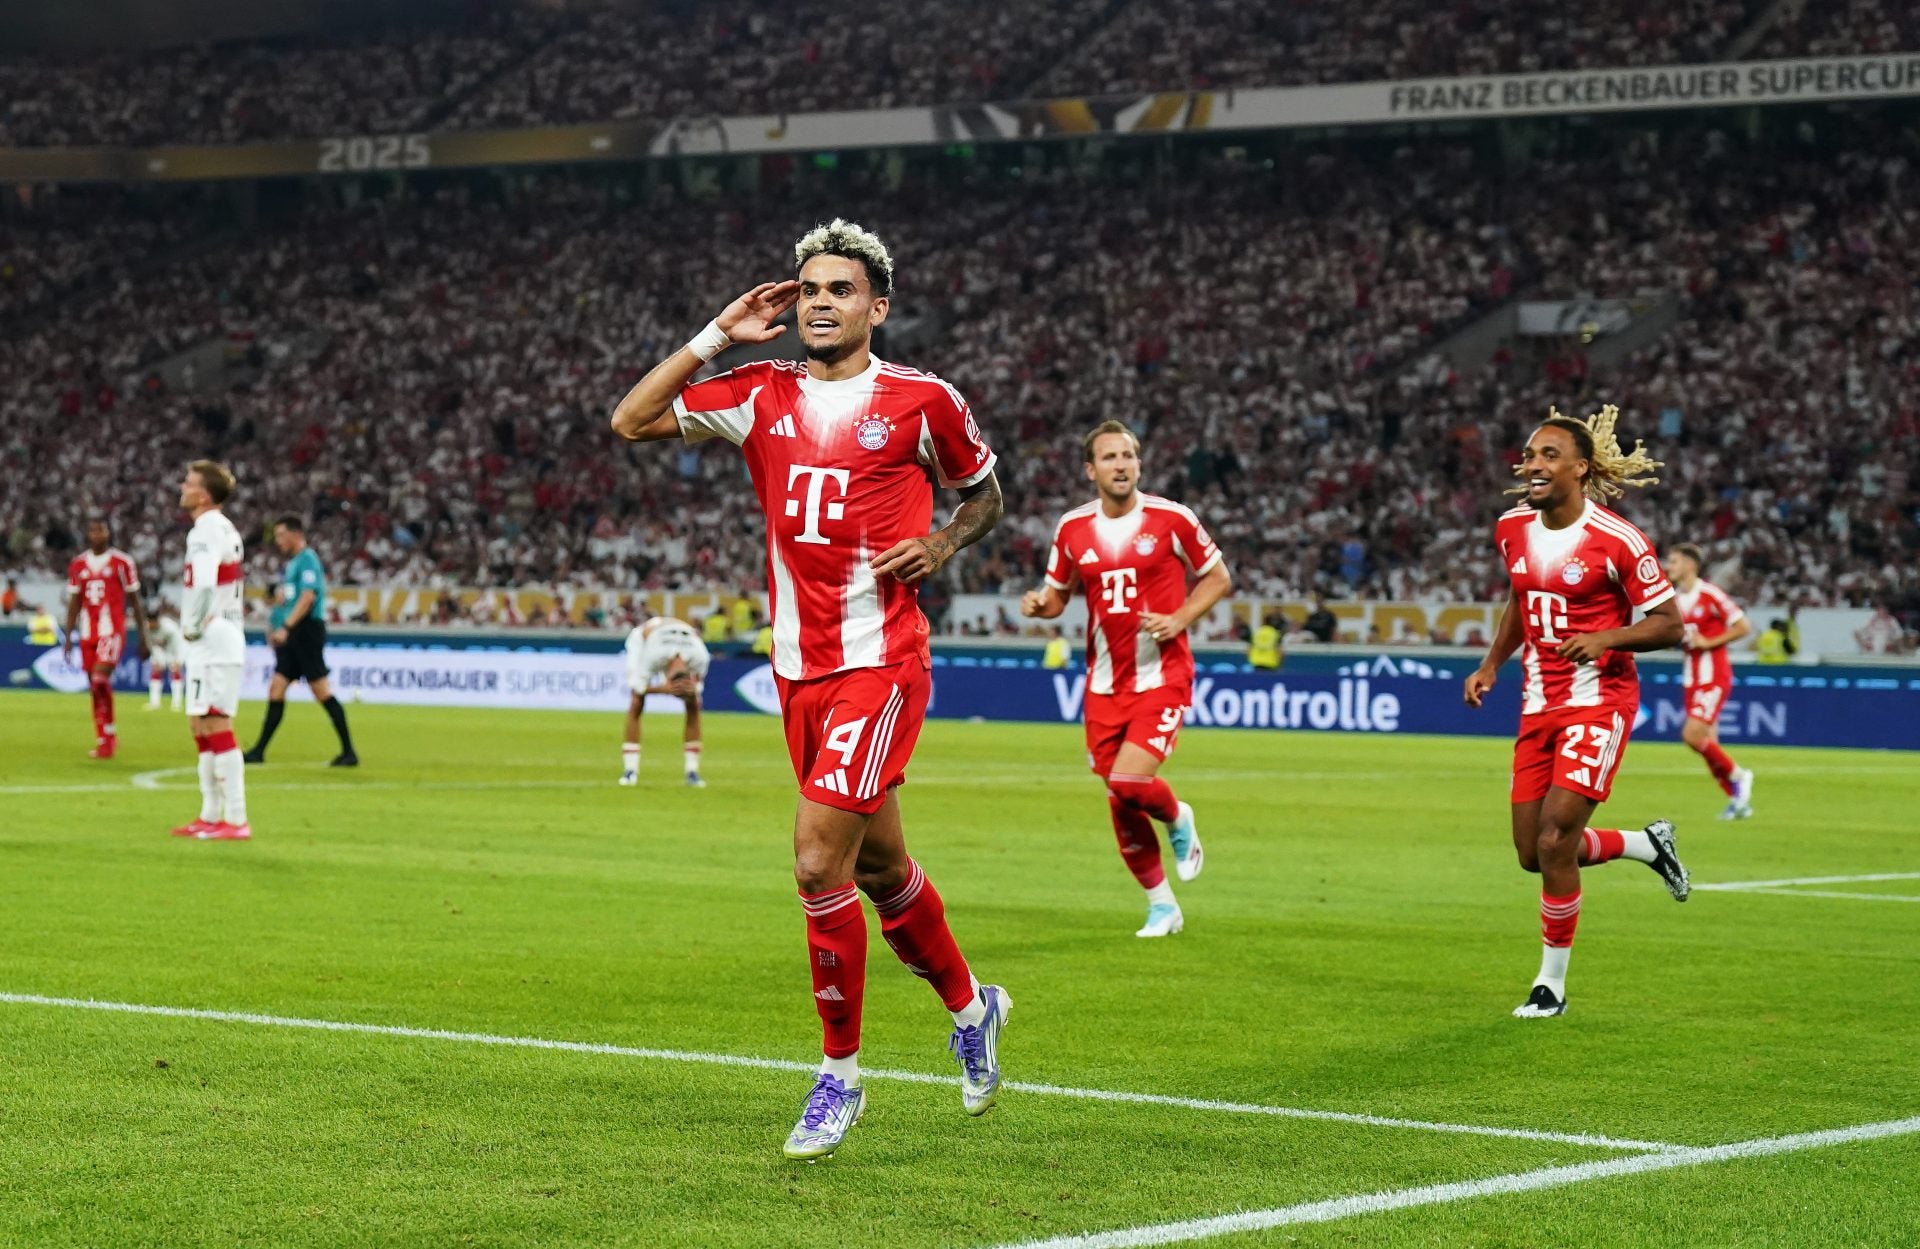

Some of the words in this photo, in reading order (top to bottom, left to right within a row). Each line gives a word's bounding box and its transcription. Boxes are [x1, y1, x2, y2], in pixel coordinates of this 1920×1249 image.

[1389, 82, 1494, 113] FRANZ
[1502, 68, 1739, 109] BECKENBAUER
[1749, 57, 1920, 97] SUPERCUP
[318, 134, 431, 171] 2025
[785, 464, 850, 545] T
[192, 679, 202, 700] 7
[339, 666, 498, 694] BECKENBAUER
[505, 668, 617, 697] SUPERCUP
[1183, 677, 1400, 732] Kontrolle
[817, 708, 869, 766] 4
[1560, 724, 1611, 768] 23
